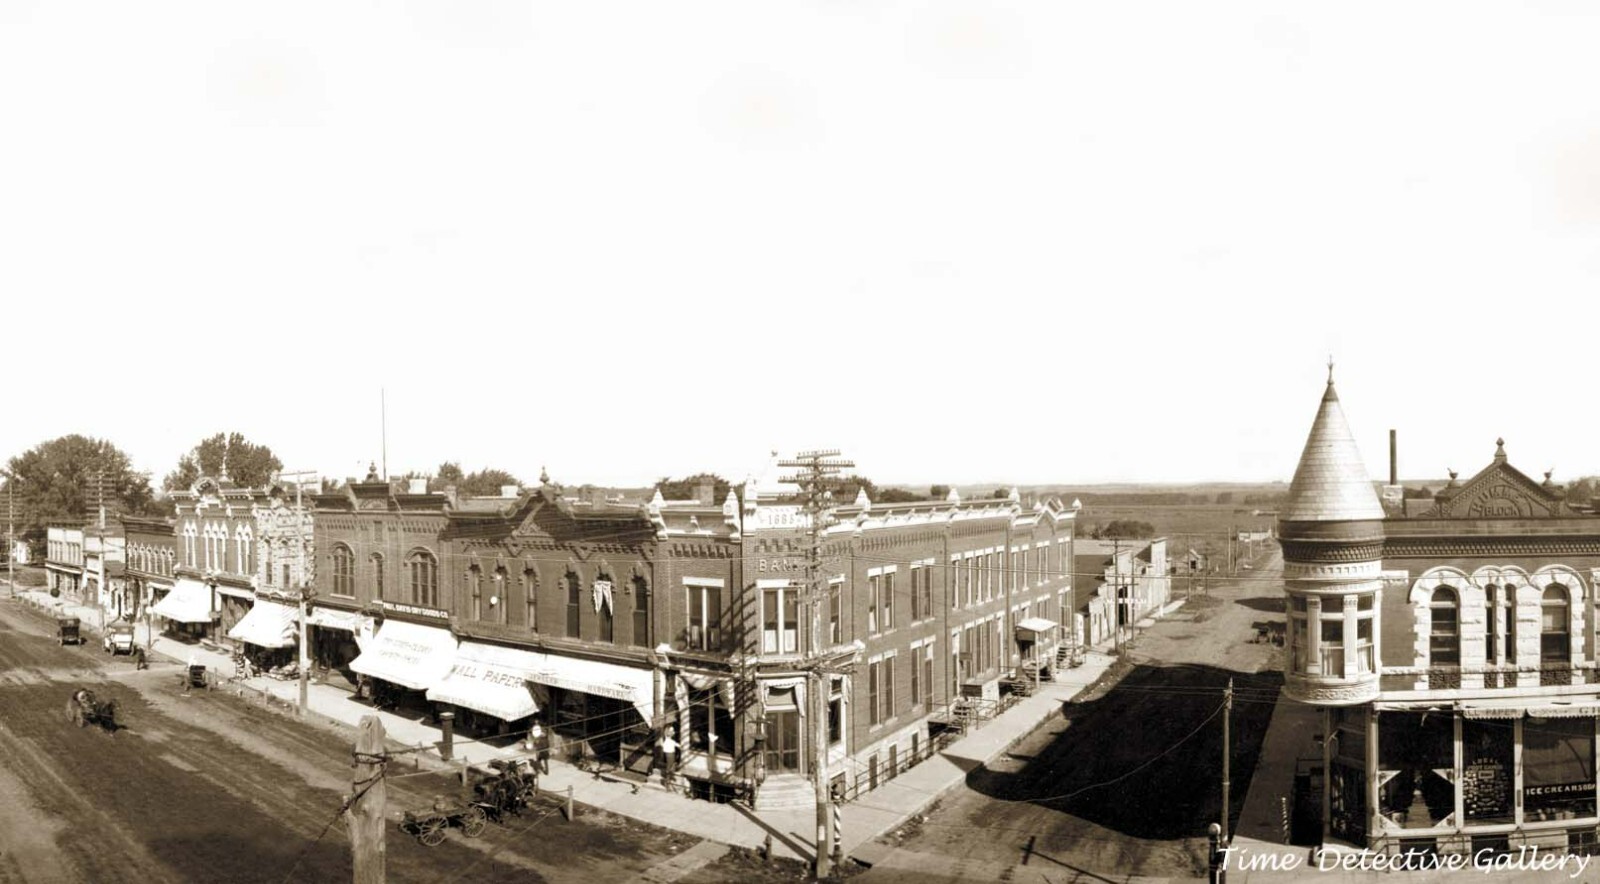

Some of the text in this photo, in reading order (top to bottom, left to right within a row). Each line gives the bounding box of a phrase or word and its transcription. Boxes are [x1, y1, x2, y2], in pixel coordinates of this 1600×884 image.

[1484, 506, 1517, 516] BLOCK
[759, 559, 801, 572] BAN
[1526, 787, 1543, 796] ICE
